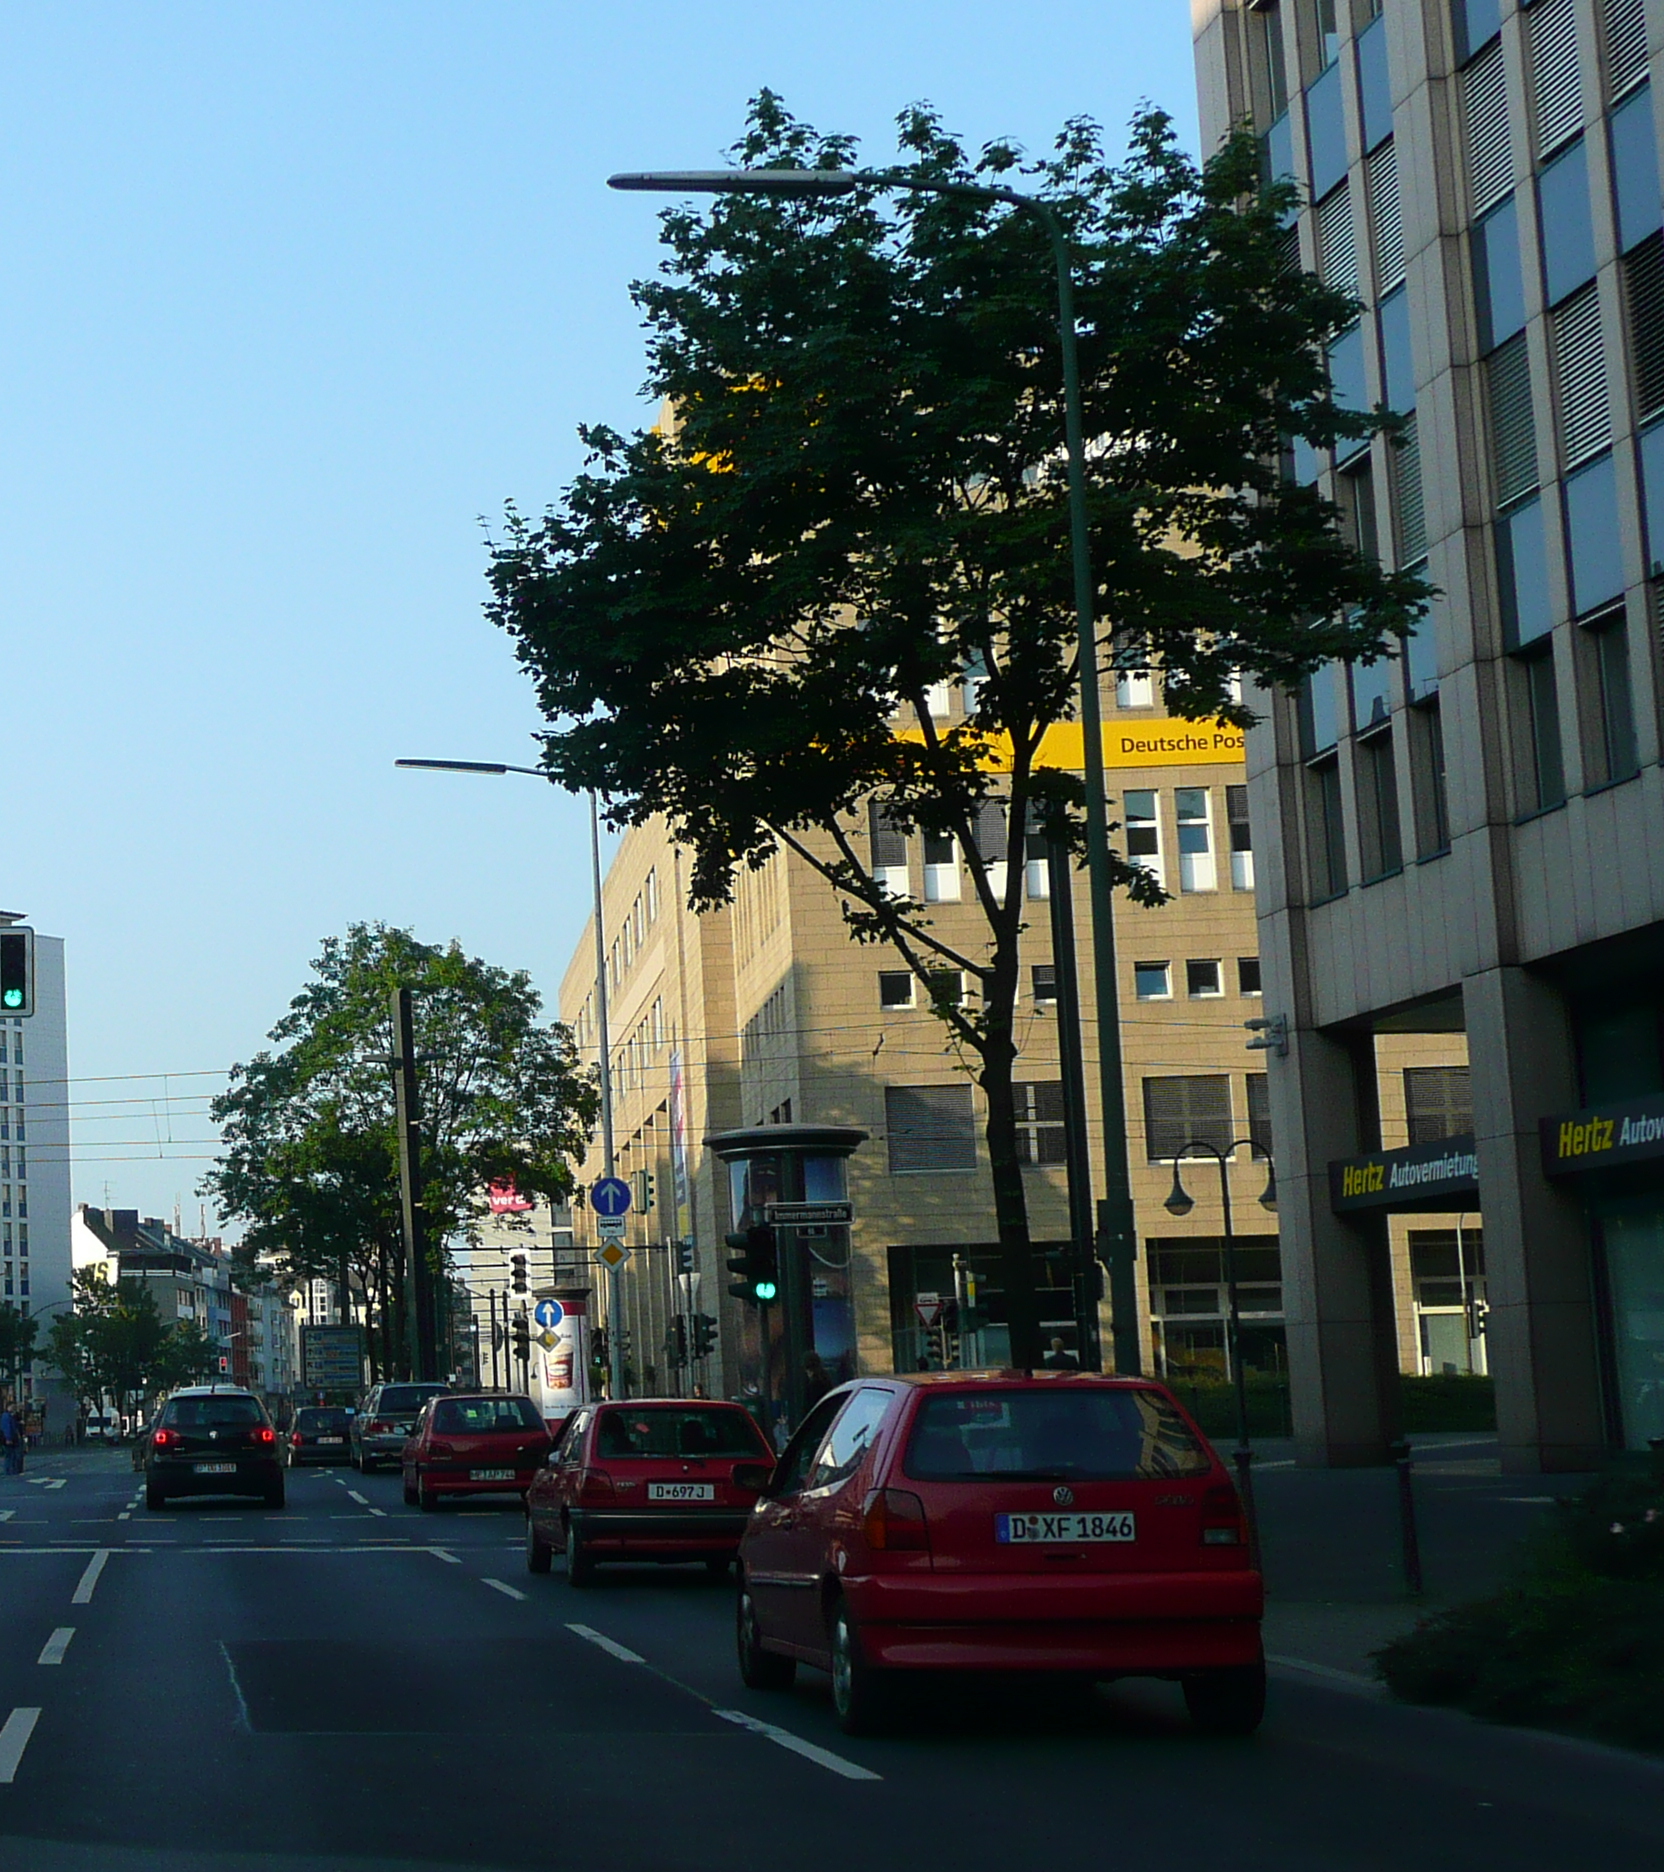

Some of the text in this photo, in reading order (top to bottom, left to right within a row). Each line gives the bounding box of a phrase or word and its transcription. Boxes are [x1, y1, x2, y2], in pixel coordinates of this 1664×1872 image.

[1121, 734, 1245, 753] Deutsche Pos
[1558, 1113, 1664, 1158] Hertz Autov
[1342, 1151, 1480, 1198] Hertz Autovermietung
[1011, 1516, 1133, 1539] D XF 1846
